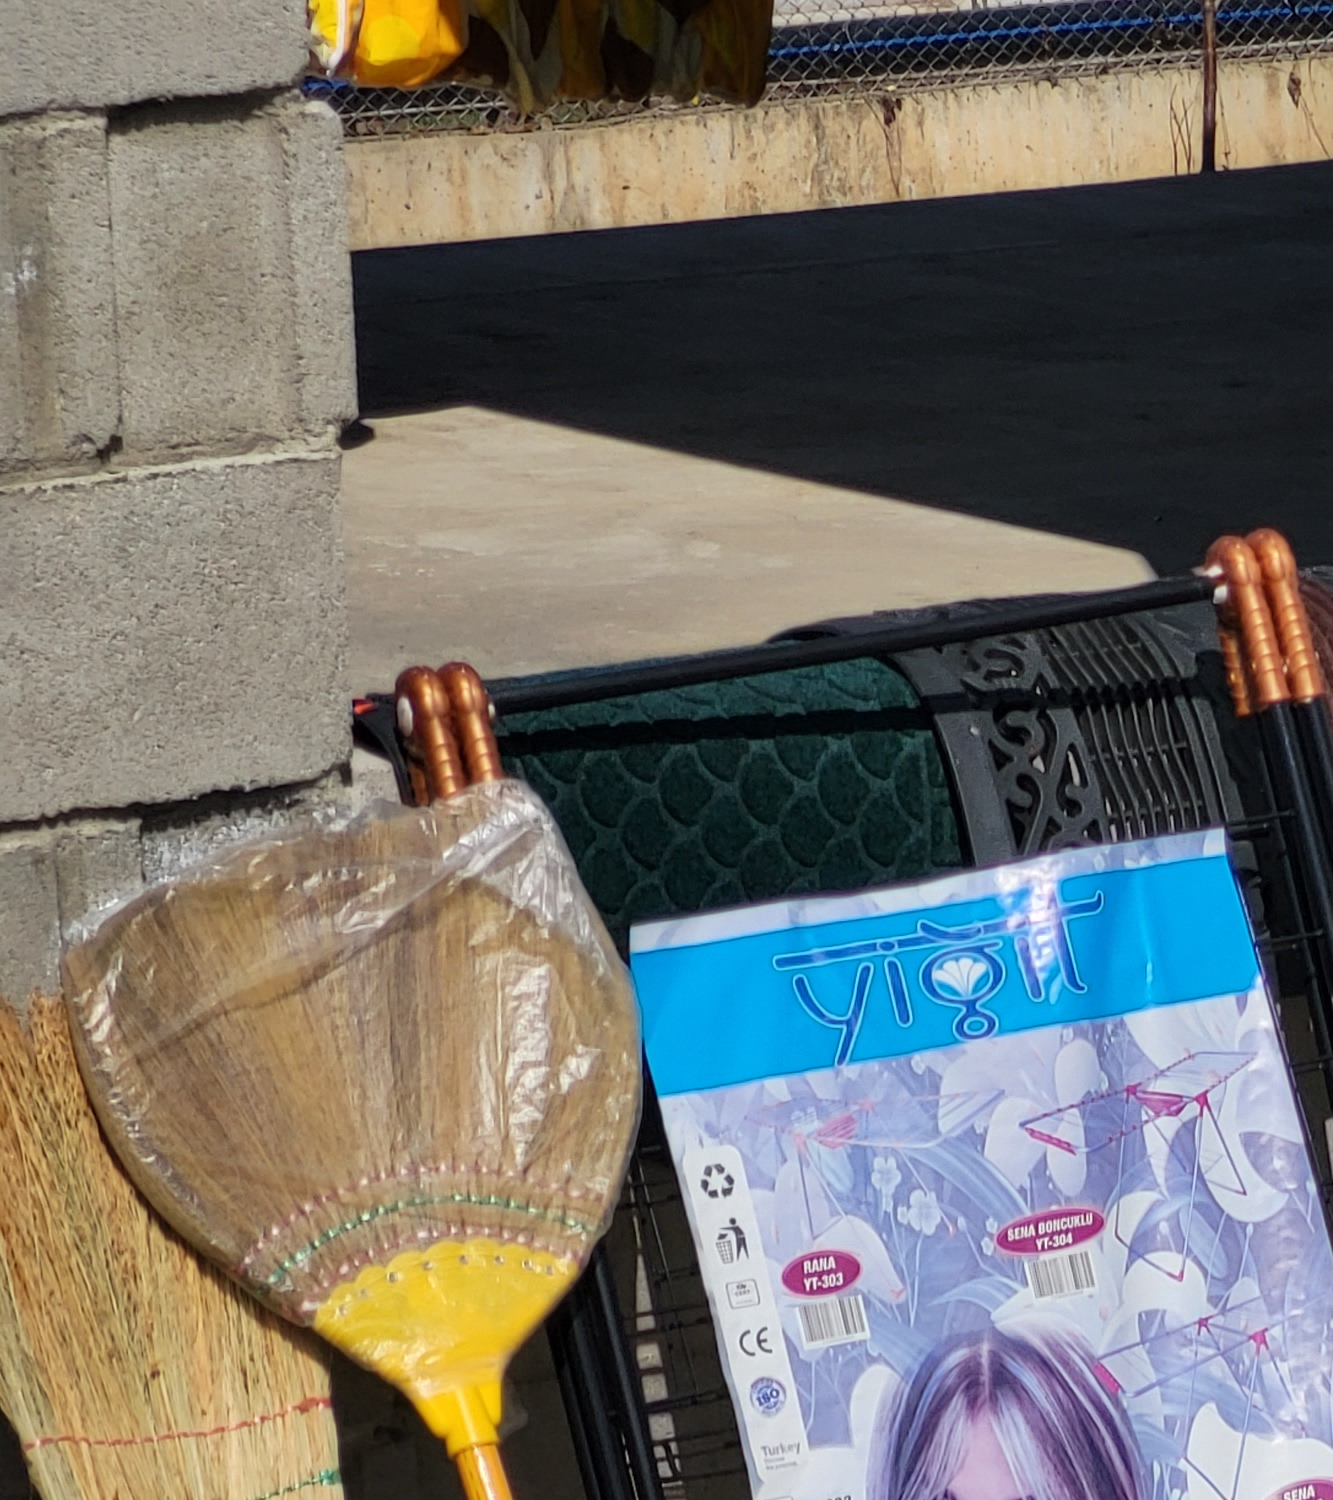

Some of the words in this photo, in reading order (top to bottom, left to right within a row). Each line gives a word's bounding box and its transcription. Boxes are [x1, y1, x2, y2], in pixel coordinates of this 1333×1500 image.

[1007, 1224, 1035, 1241] SENA
[1035, 1232, 1073, 1251] YT-304
[803, 1256, 836, 1274] RANA
[804, 1272, 843, 1292] YT-303
[761, 1440, 801, 1458] Turkey
